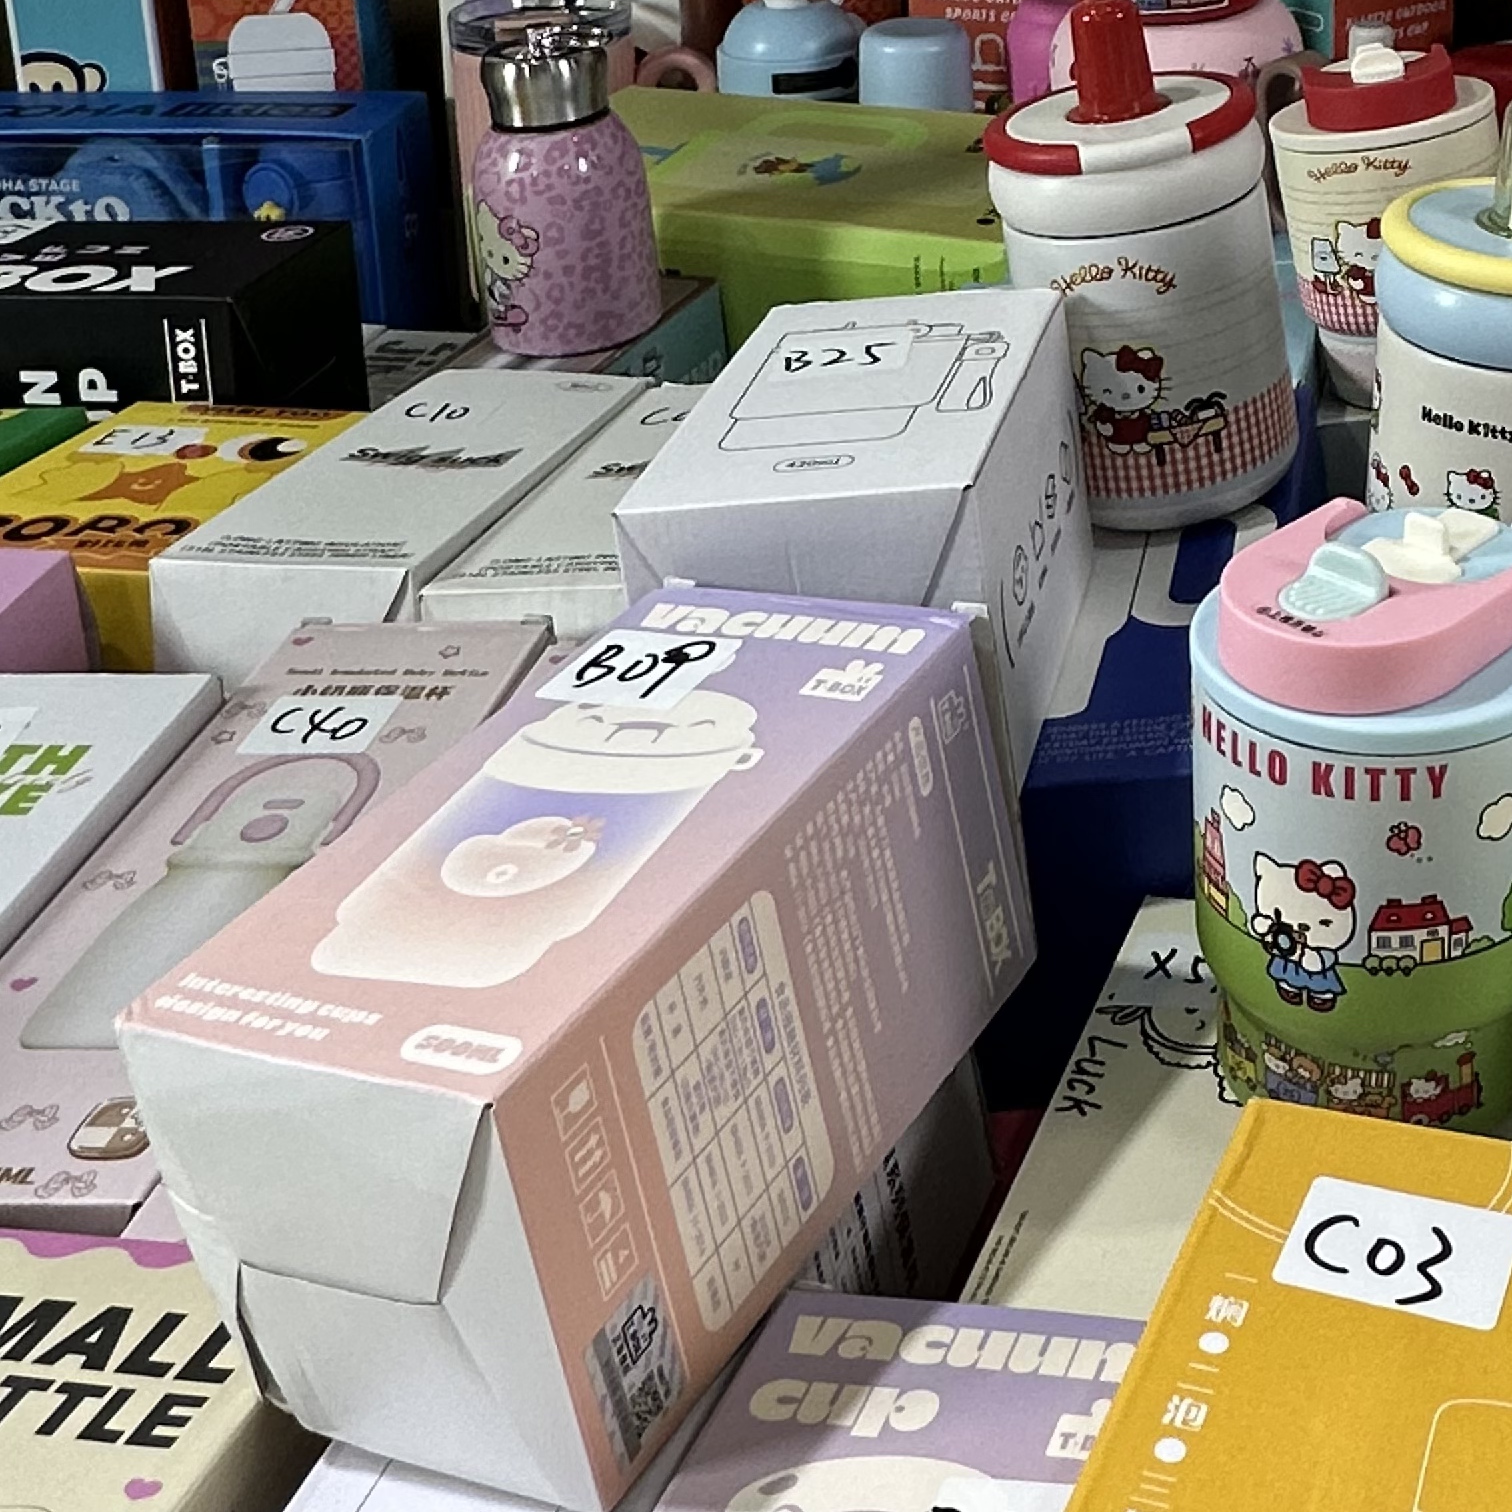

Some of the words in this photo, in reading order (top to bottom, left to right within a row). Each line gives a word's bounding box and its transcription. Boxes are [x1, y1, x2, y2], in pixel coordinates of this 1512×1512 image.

[1309, 161, 1357, 184] Hello
[1360, 156, 1413, 177] Kitty
[1051, 263, 1114, 296] Hello
[1118, 256, 1178, 295] Kitty
[1421, 405, 1465, 433] Hello
[1200, 704, 1290, 788] HELLO
[1311, 761, 1449, 803] KITTY
[278, 1014, 331, 1042] you
[0, 1166, 35, 1185] ML
[1304, 1213, 1453, 1306] C03
